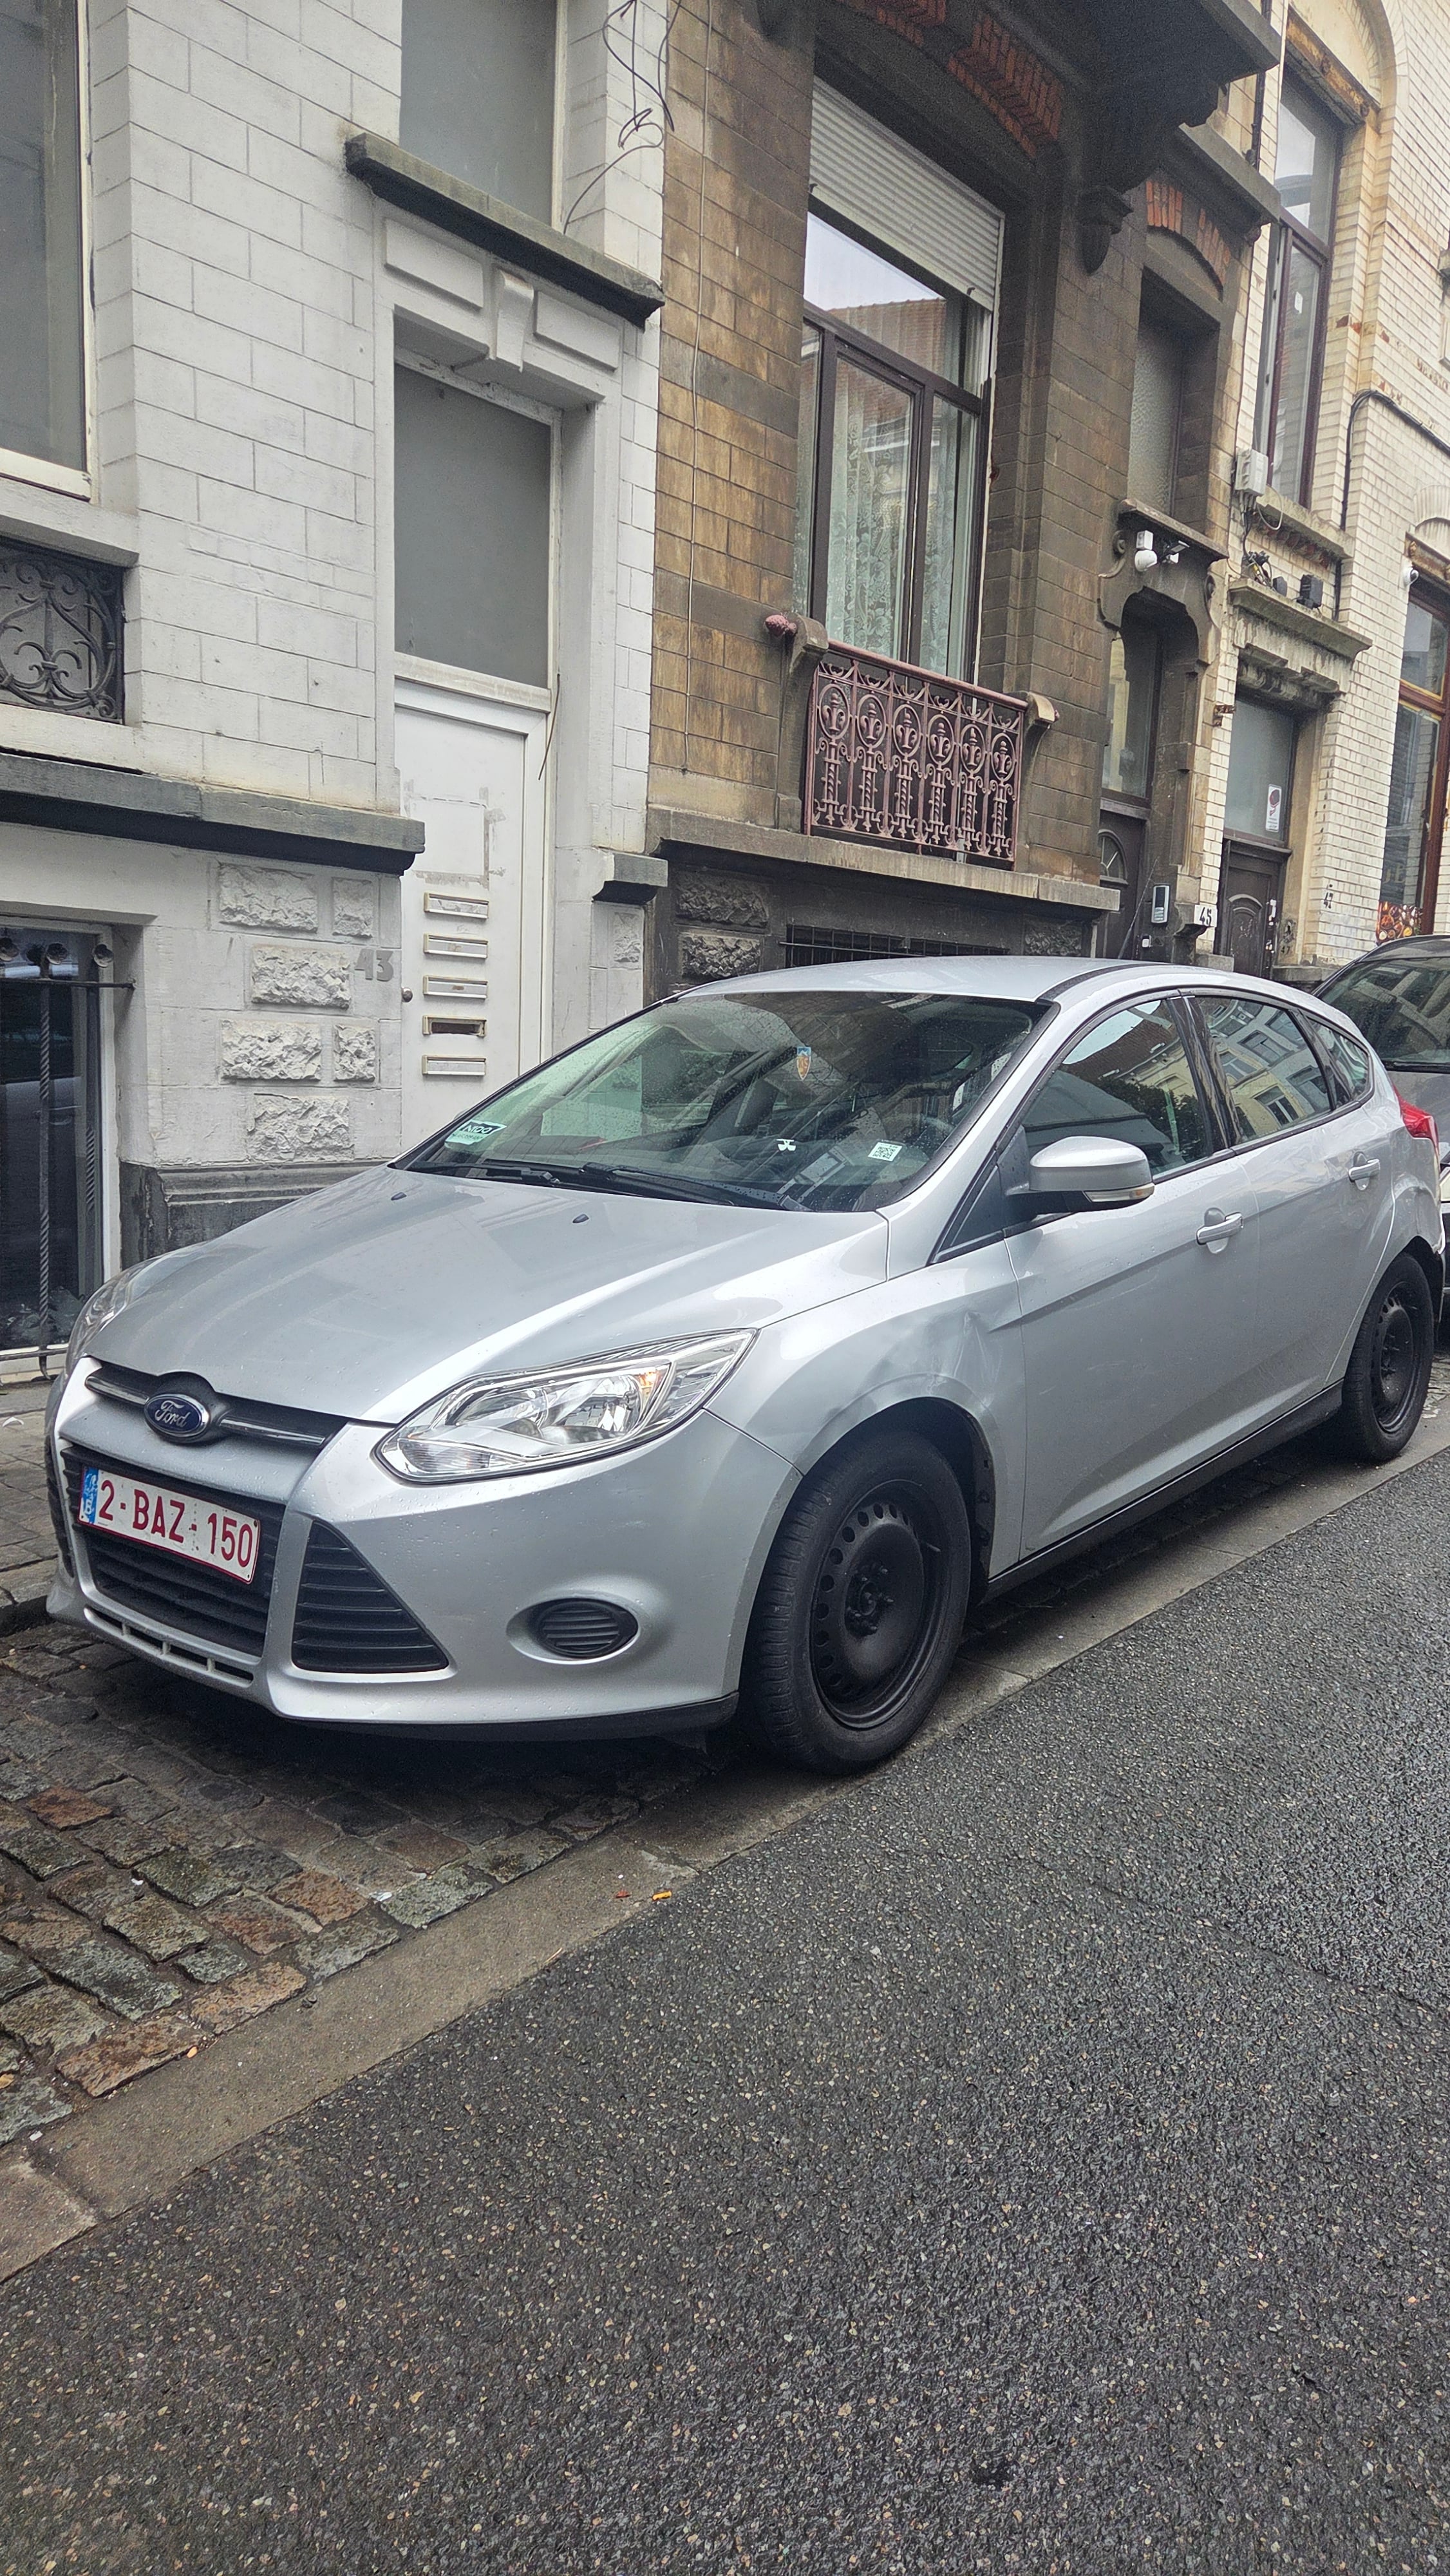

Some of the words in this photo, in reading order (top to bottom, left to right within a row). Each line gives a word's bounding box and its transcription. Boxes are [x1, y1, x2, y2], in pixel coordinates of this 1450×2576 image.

[1199, 907, 1212, 926] 45
[353, 949, 393, 982] 43
[155, 1400, 191, 1427] Ford
